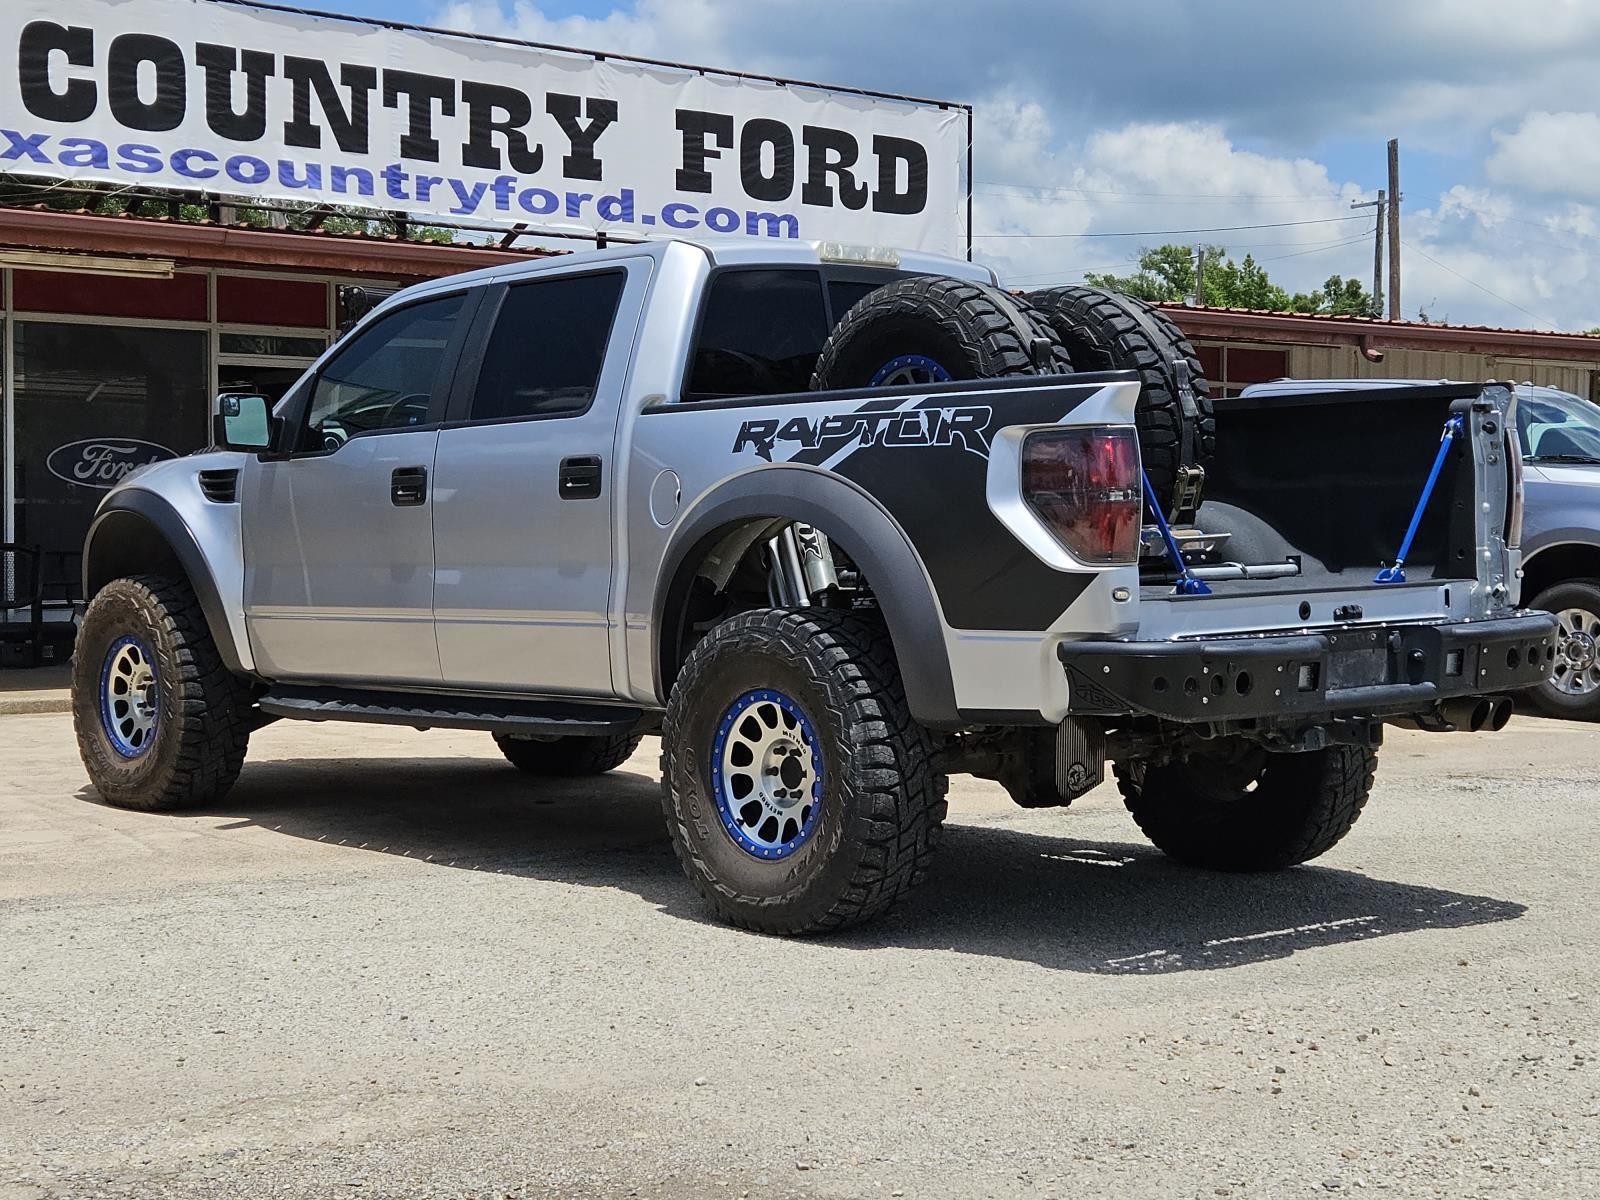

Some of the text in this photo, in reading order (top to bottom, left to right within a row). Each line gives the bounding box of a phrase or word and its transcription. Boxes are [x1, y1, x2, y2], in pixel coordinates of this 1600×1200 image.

[19, 20, 929, 216] COUNTRY FORD
[0, 130, 799, 239] xascountryford.com
[731, 405, 991, 463] RAPTOR
[73, 444, 158, 480] For
[782, 730, 807, 755] METHOD
[758, 791, 783, 817] METHOD
